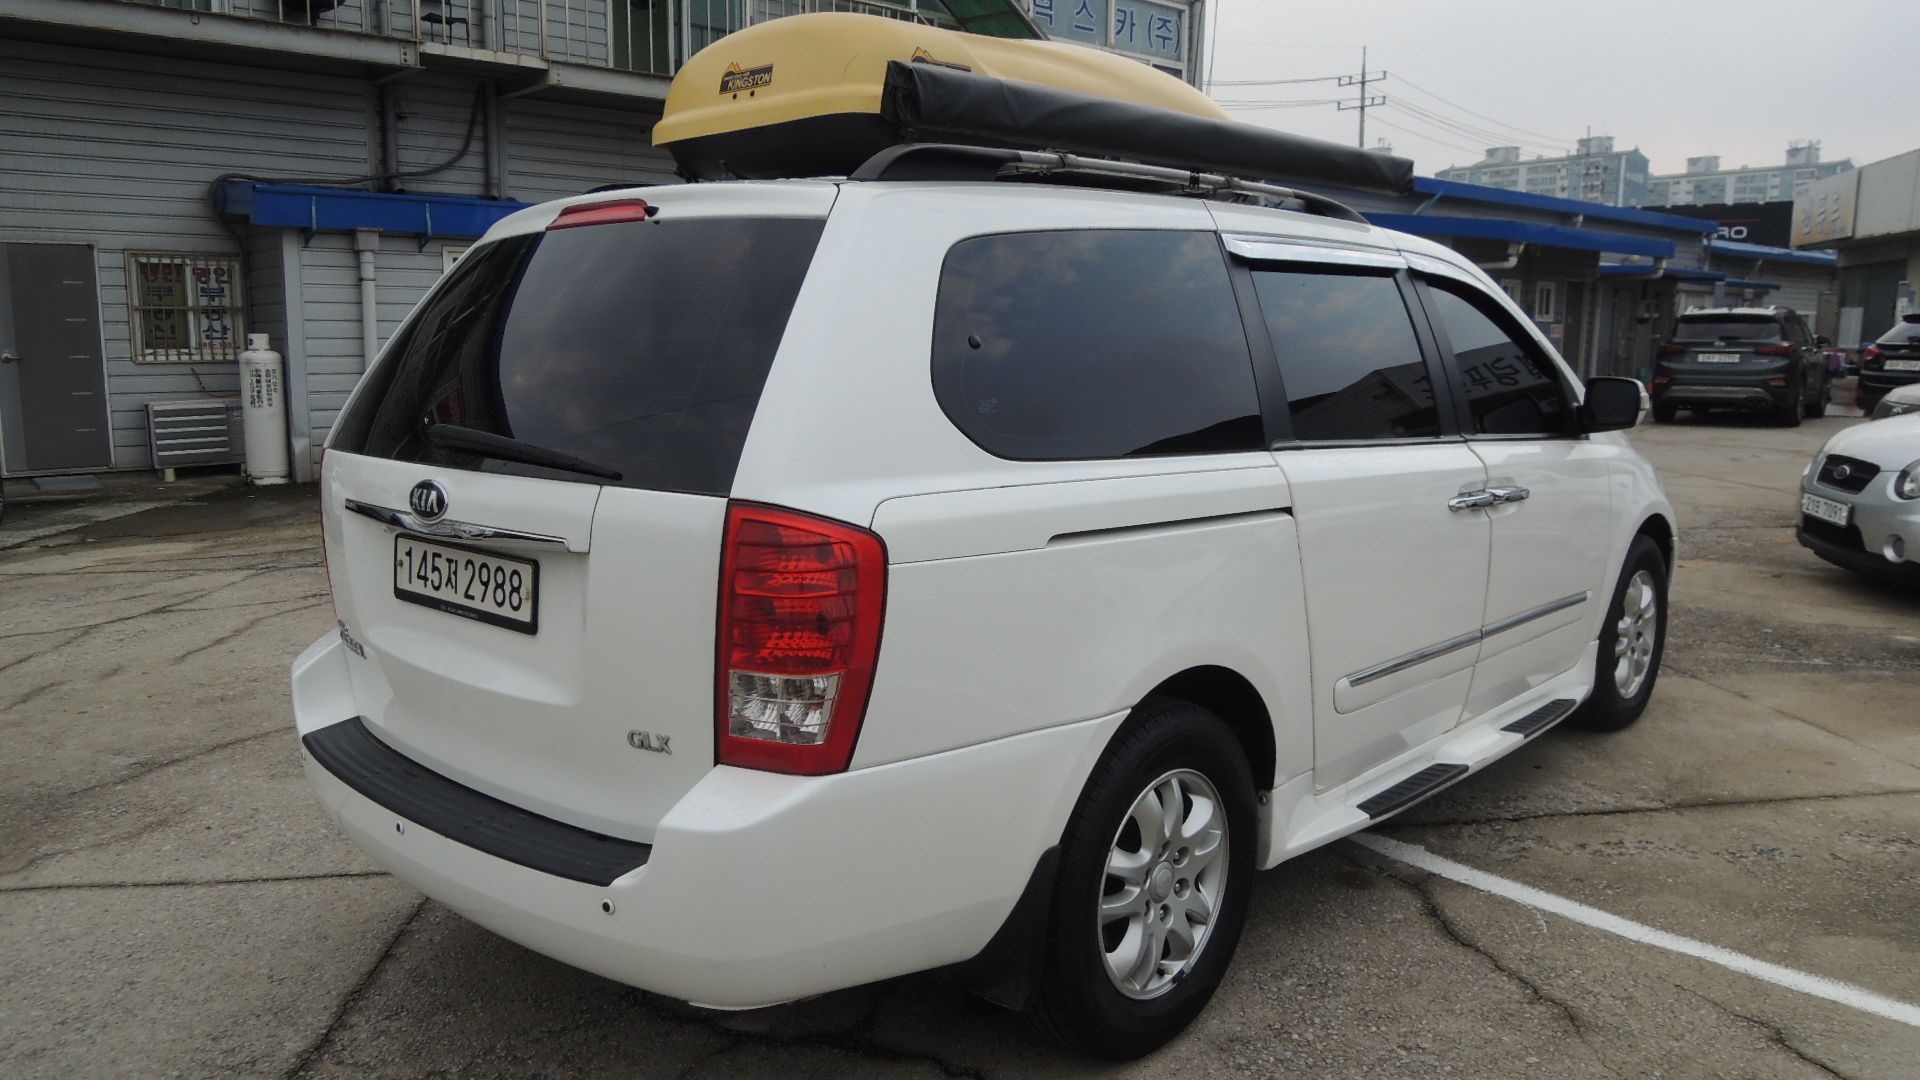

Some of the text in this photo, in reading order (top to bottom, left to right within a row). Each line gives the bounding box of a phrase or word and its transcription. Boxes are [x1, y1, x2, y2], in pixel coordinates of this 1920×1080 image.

[728, 72, 771, 90] KINGSTON
[412, 487, 439, 513] KIA
[464, 559, 522, 612] 2988
[627, 730, 672, 755] GLX
